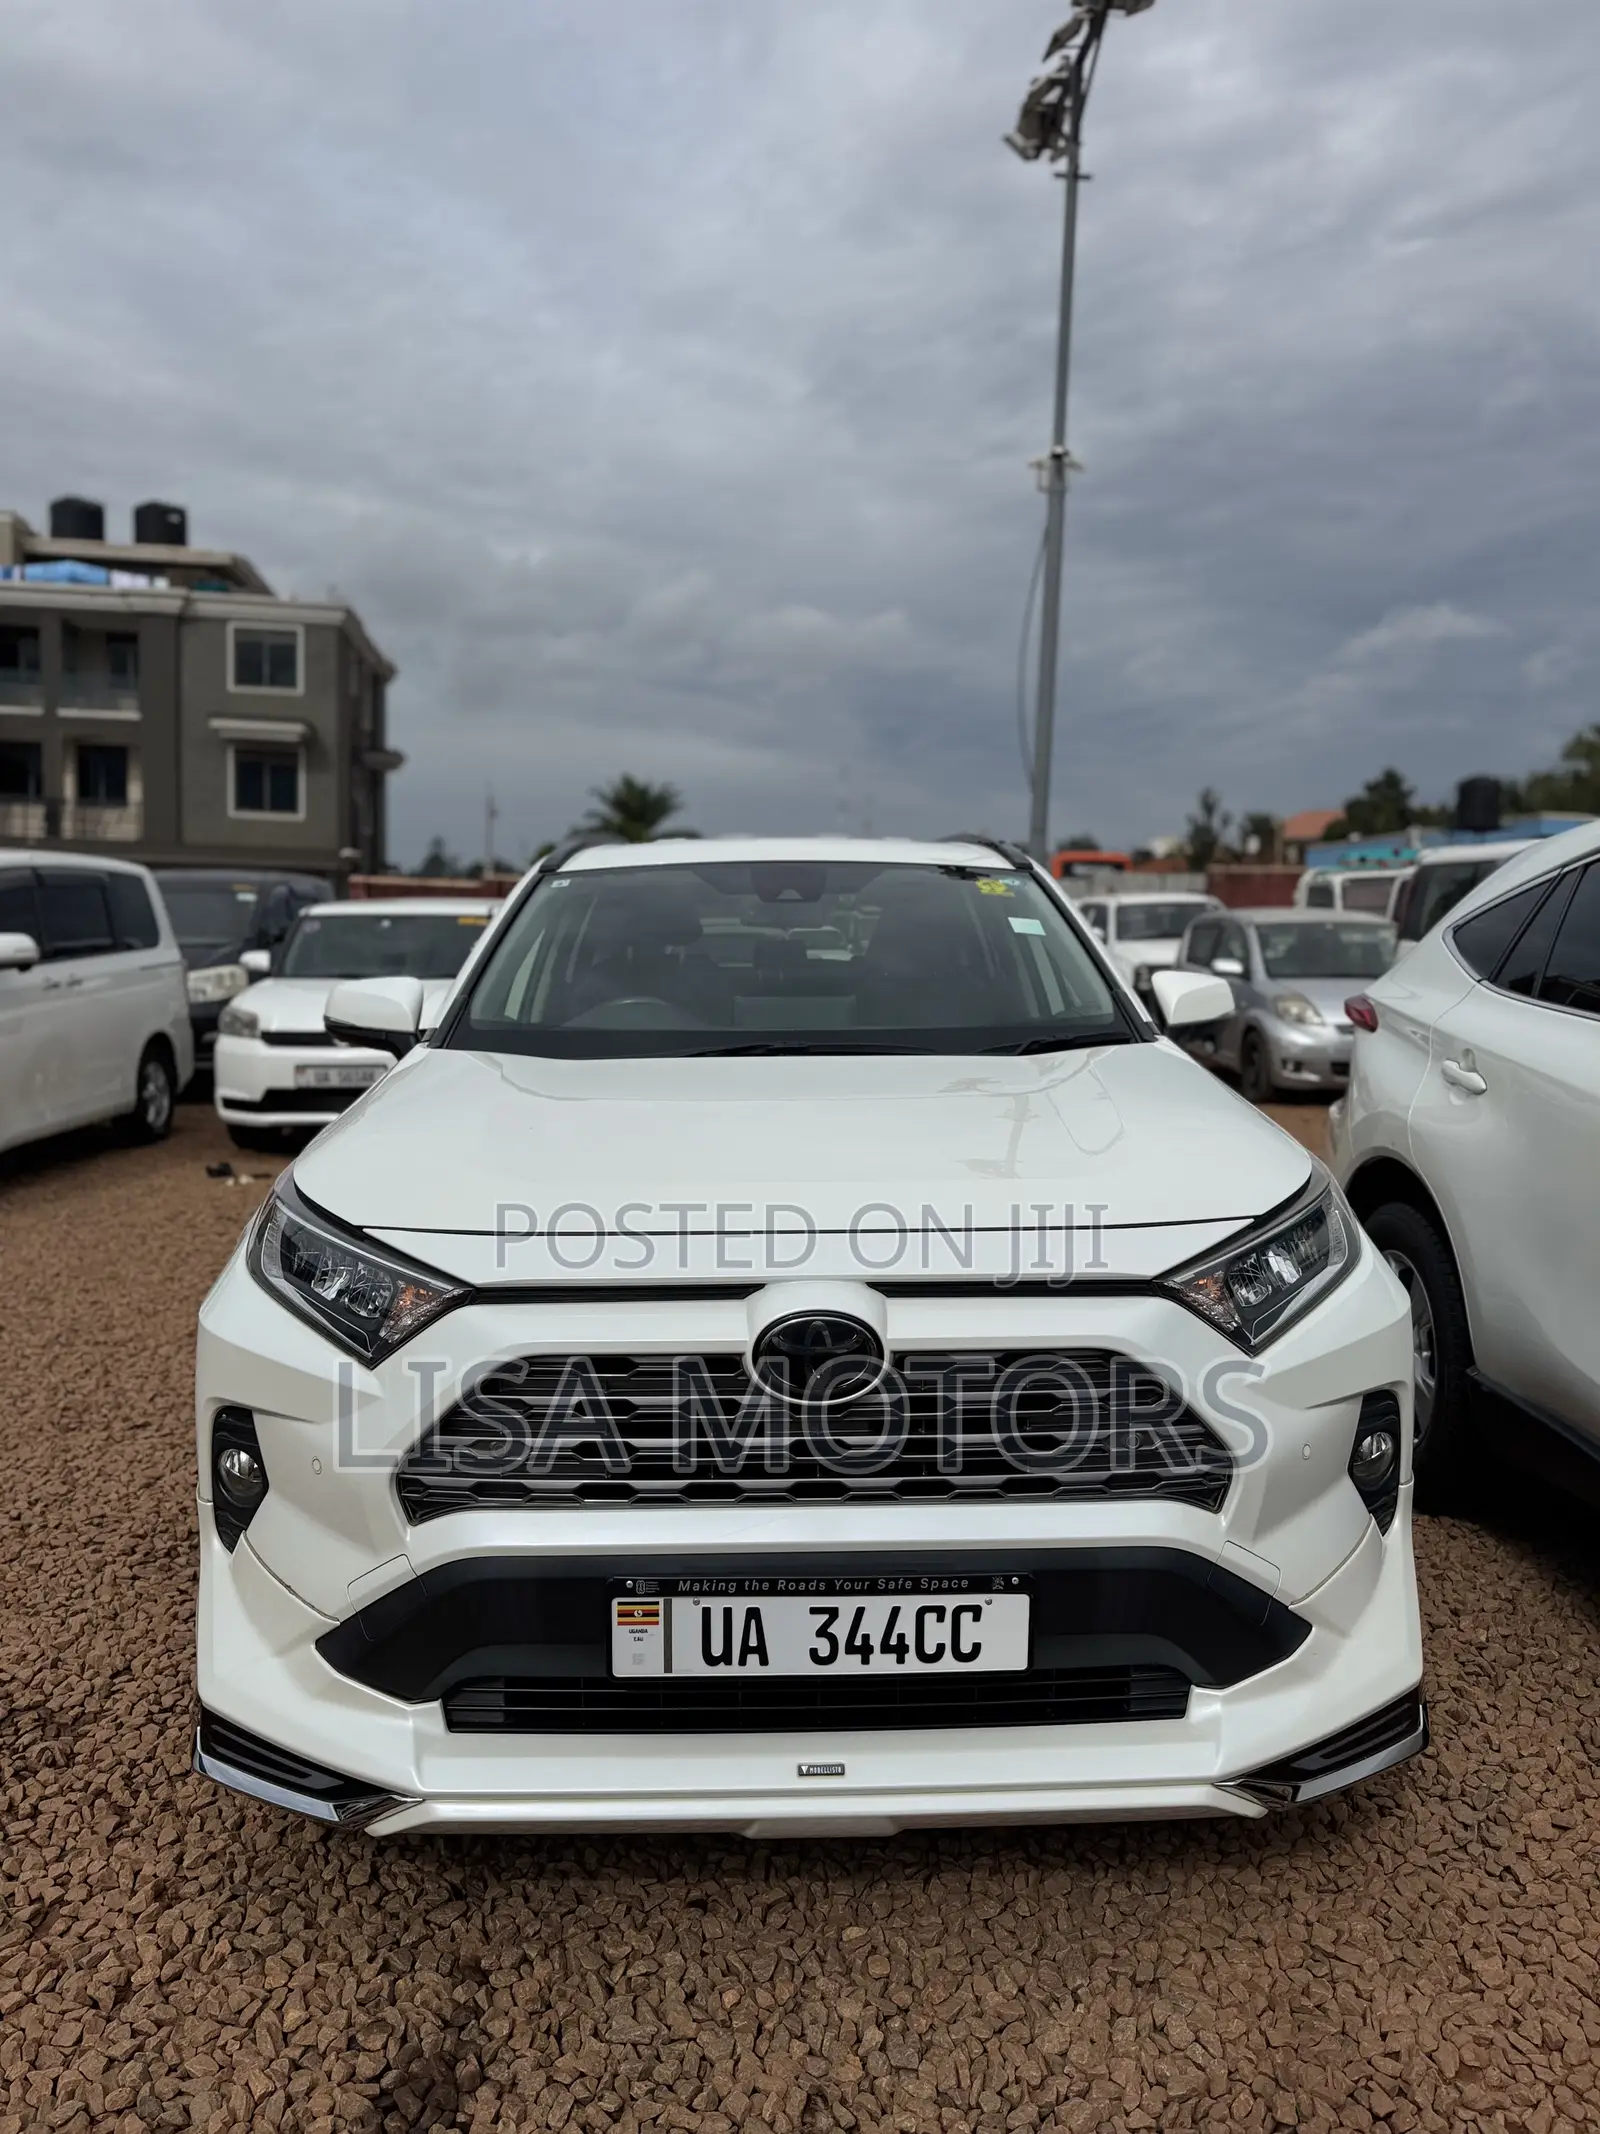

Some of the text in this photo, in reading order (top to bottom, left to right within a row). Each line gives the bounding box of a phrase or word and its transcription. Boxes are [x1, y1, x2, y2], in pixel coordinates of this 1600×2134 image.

[678, 1578, 969, 1593] Making the Roads Your Safe Space
[702, 1604, 983, 1667] UA 344CC
